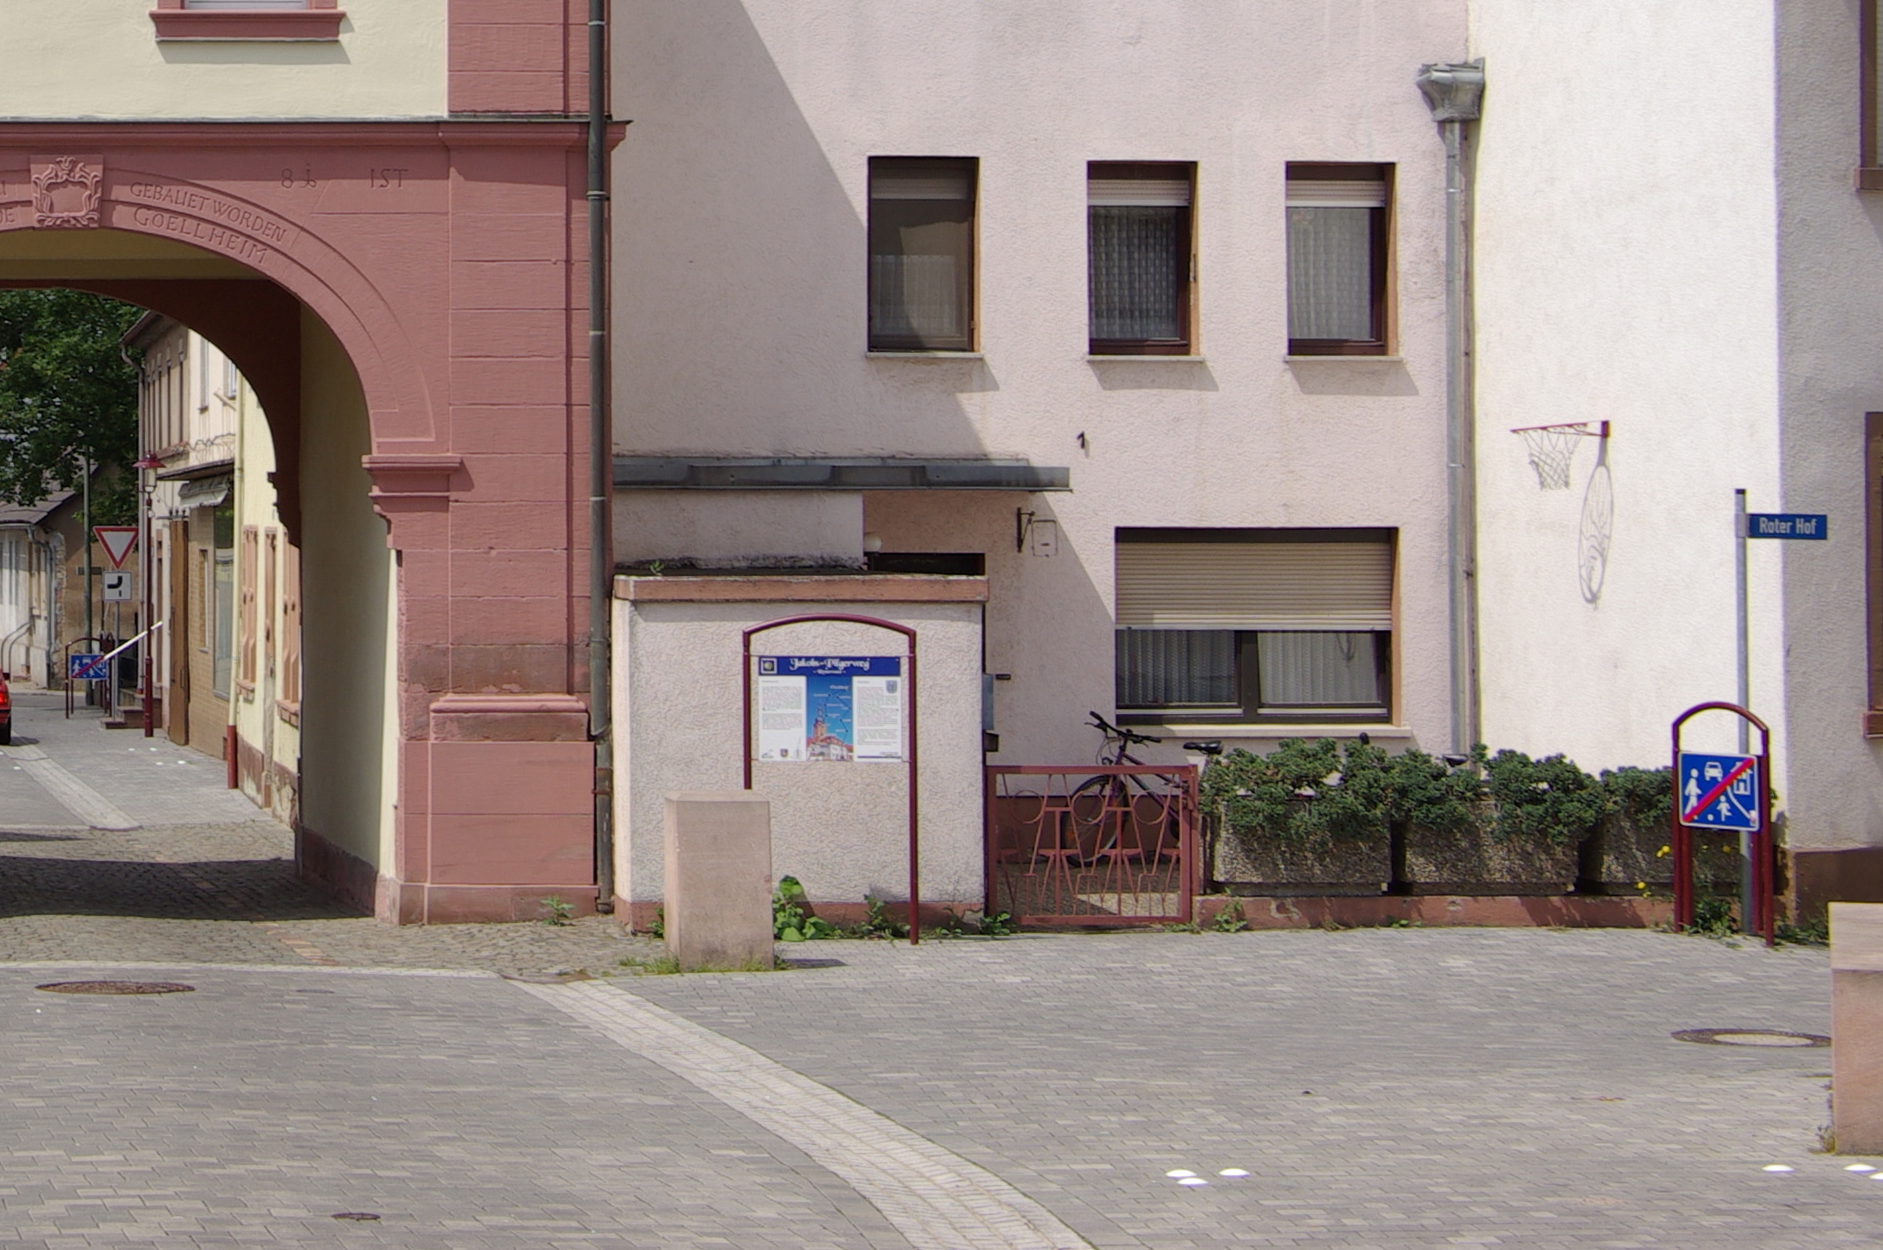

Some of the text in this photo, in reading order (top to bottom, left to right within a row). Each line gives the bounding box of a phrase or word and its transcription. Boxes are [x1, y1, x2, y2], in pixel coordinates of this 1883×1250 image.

[369, 168, 409, 188] IST
[129, 181, 211, 212] GEBAUET
[212, 199, 287, 244] WORDEN
[133, 206, 269, 265] GOELLHEIM
[1759, 517, 1817, 534] Roter Hof
